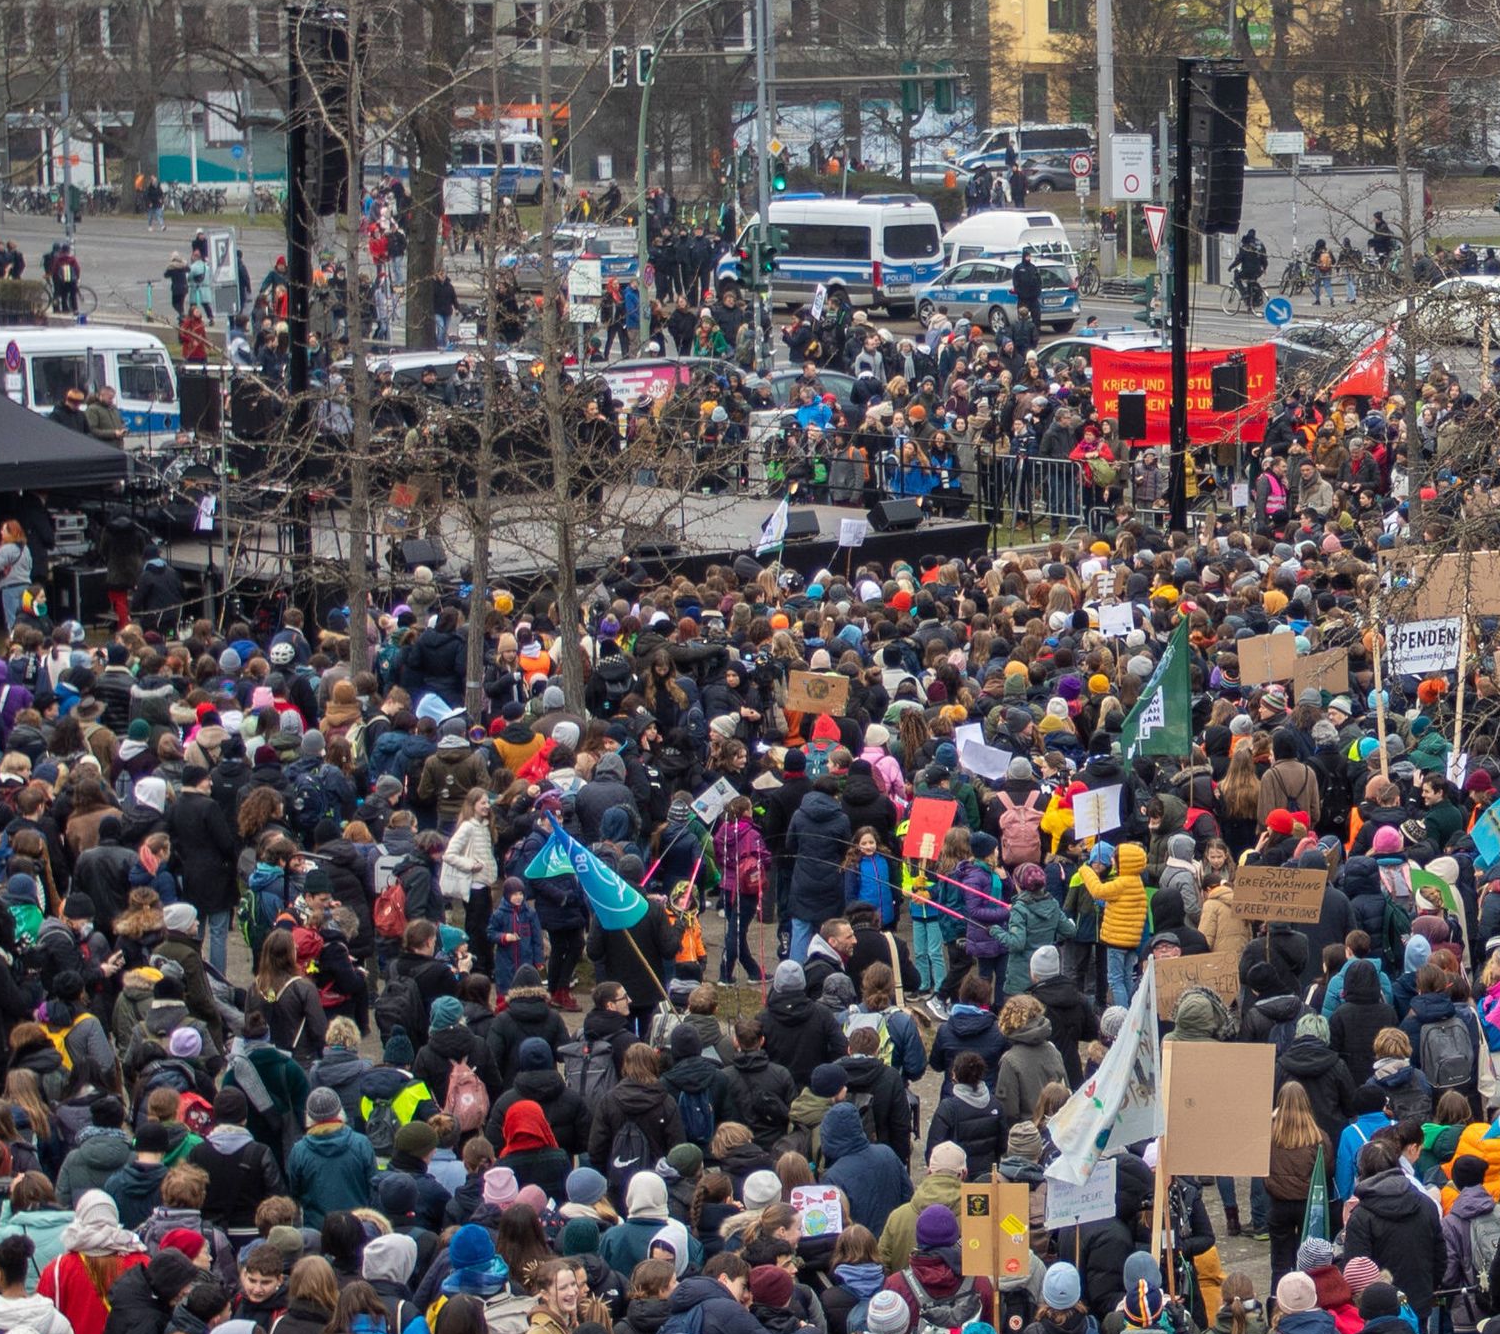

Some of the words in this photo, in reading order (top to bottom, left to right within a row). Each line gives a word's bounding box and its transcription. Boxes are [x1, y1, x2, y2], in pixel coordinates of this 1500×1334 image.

[885, 274, 913, 283] POLIZEI
[1143, 378, 1165, 392] UND
[1391, 627, 1456, 651] SPENDEN
[1262, 867, 1301, 879] STOP
[1238, 876, 1321, 890] GREENWASHING
[1261, 889, 1300, 902] START
[1236, 903, 1270, 915] GREEN
[1276, 907, 1317, 919] ACTIONS
